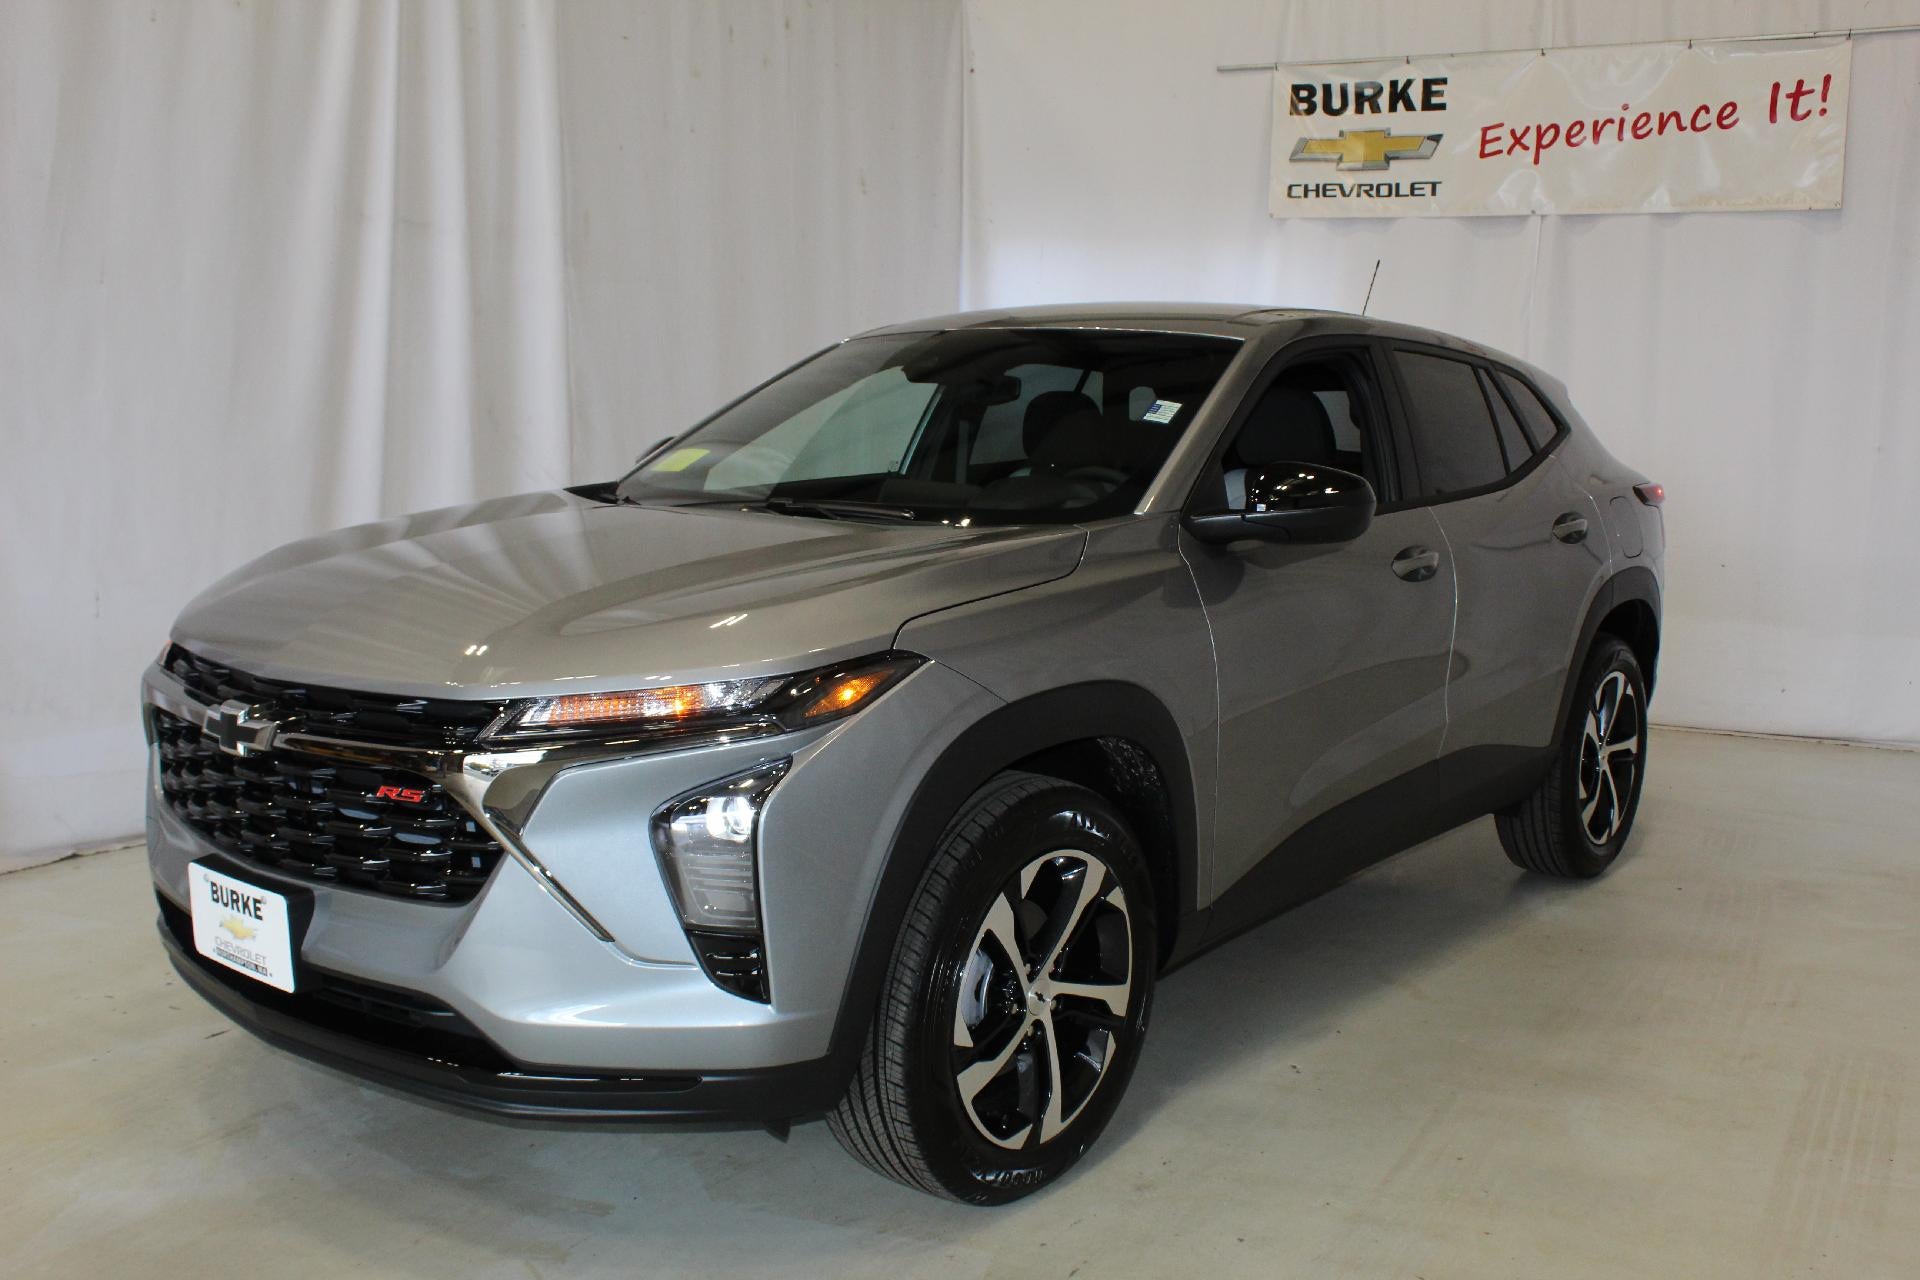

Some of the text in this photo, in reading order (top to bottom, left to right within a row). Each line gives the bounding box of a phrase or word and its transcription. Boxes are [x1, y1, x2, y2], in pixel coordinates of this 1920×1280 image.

[1289, 77, 1448, 116] BURKE
[1479, 73, 1833, 165] Experience It!
[1287, 181, 1442, 199] CHEVROLET
[376, 785, 425, 803] RS
[210, 881, 263, 920] BURKE
[214, 936, 266, 966] CHEVROLET
